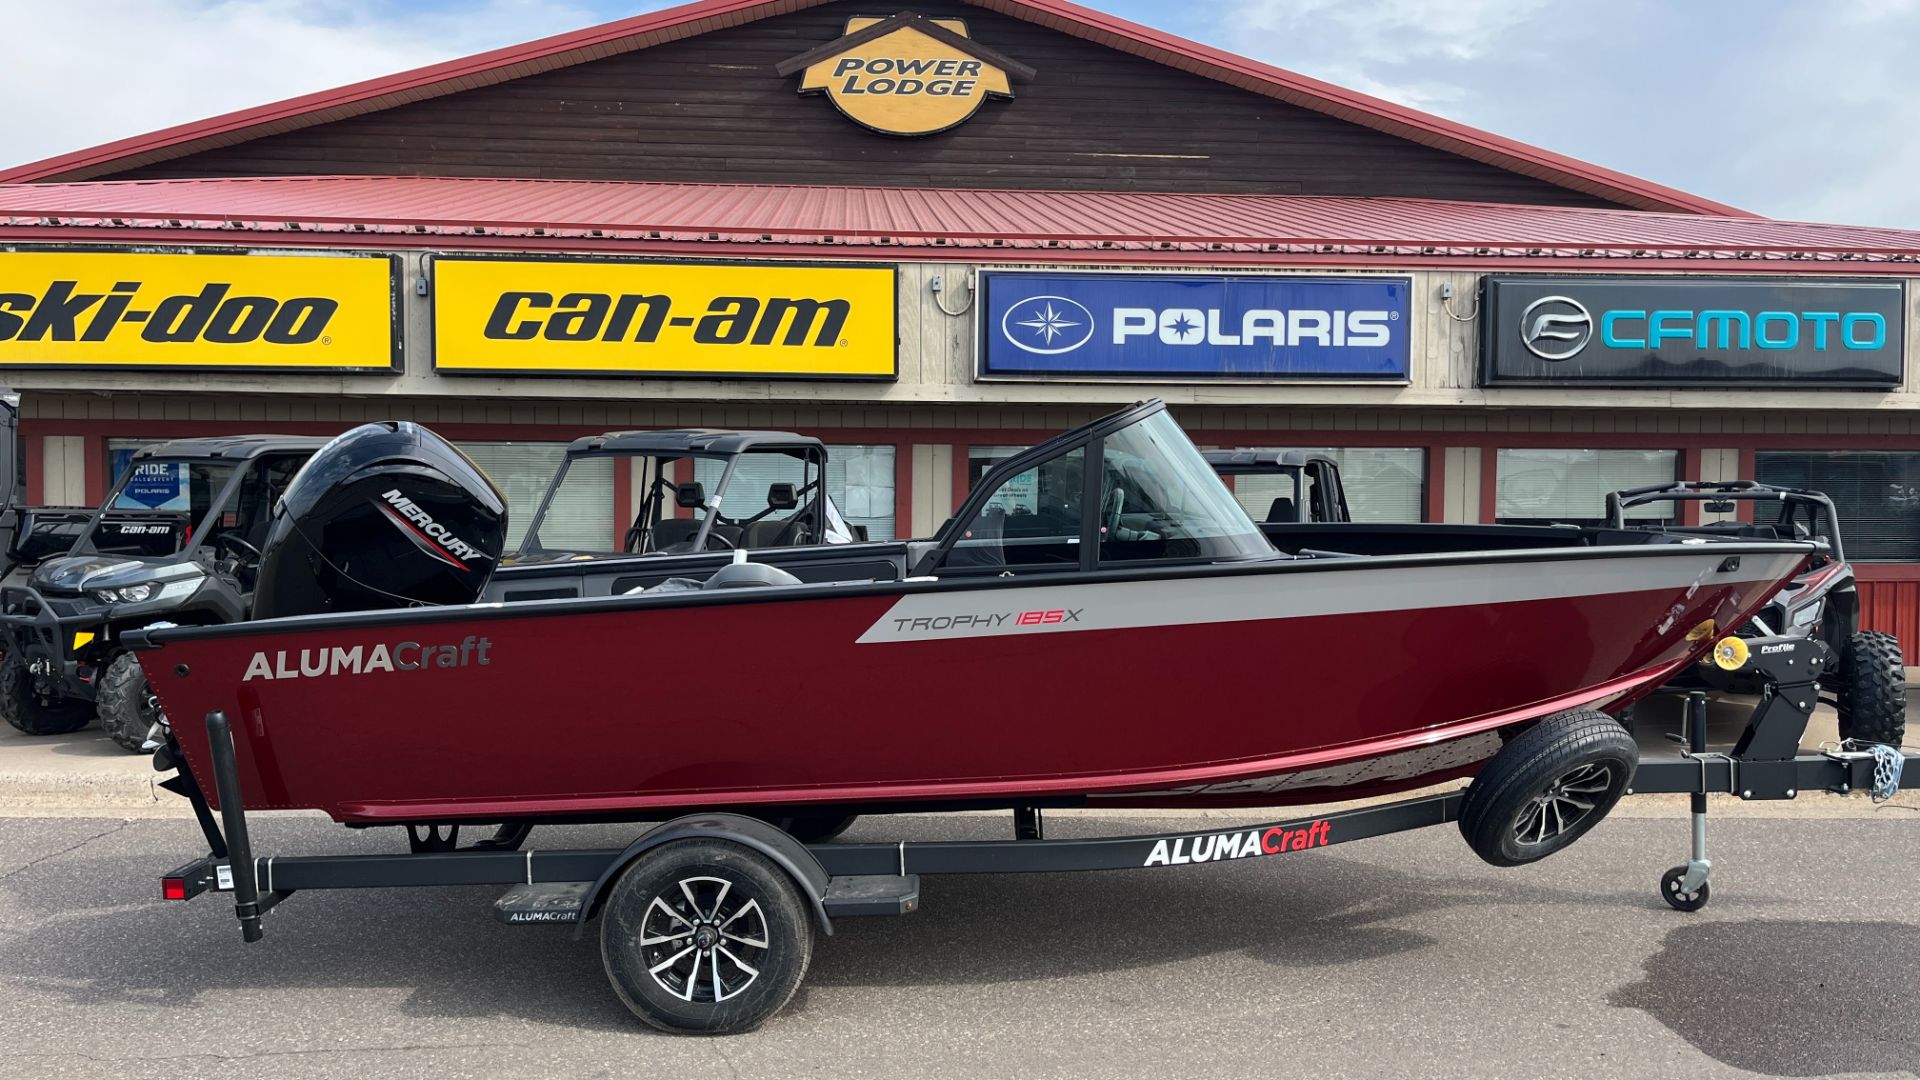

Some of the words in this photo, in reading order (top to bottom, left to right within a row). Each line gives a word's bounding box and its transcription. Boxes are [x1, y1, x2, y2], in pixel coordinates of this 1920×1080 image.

[833, 58, 982, 77] POWER
[841, 75, 976, 96] LODGE
[0, 280, 339, 344] ski-doo
[483, 291, 851, 347] can-am
[1112, 307, 1391, 347] POLARIS
[1601, 309, 1887, 351] CFMOTO
[120, 525, 170, 534] can-am
[381, 489, 481, 560] MERCURY
[894, 613, 1012, 632] TROPHY
[1015, 608, 1084, 626] 185X
[242, 635, 492, 681] ALUMACraft
[1761, 643, 1795, 654] Profile
[1144, 820, 1331, 866] ALUMACraft
[510, 911, 576, 921] ALUMACraft
